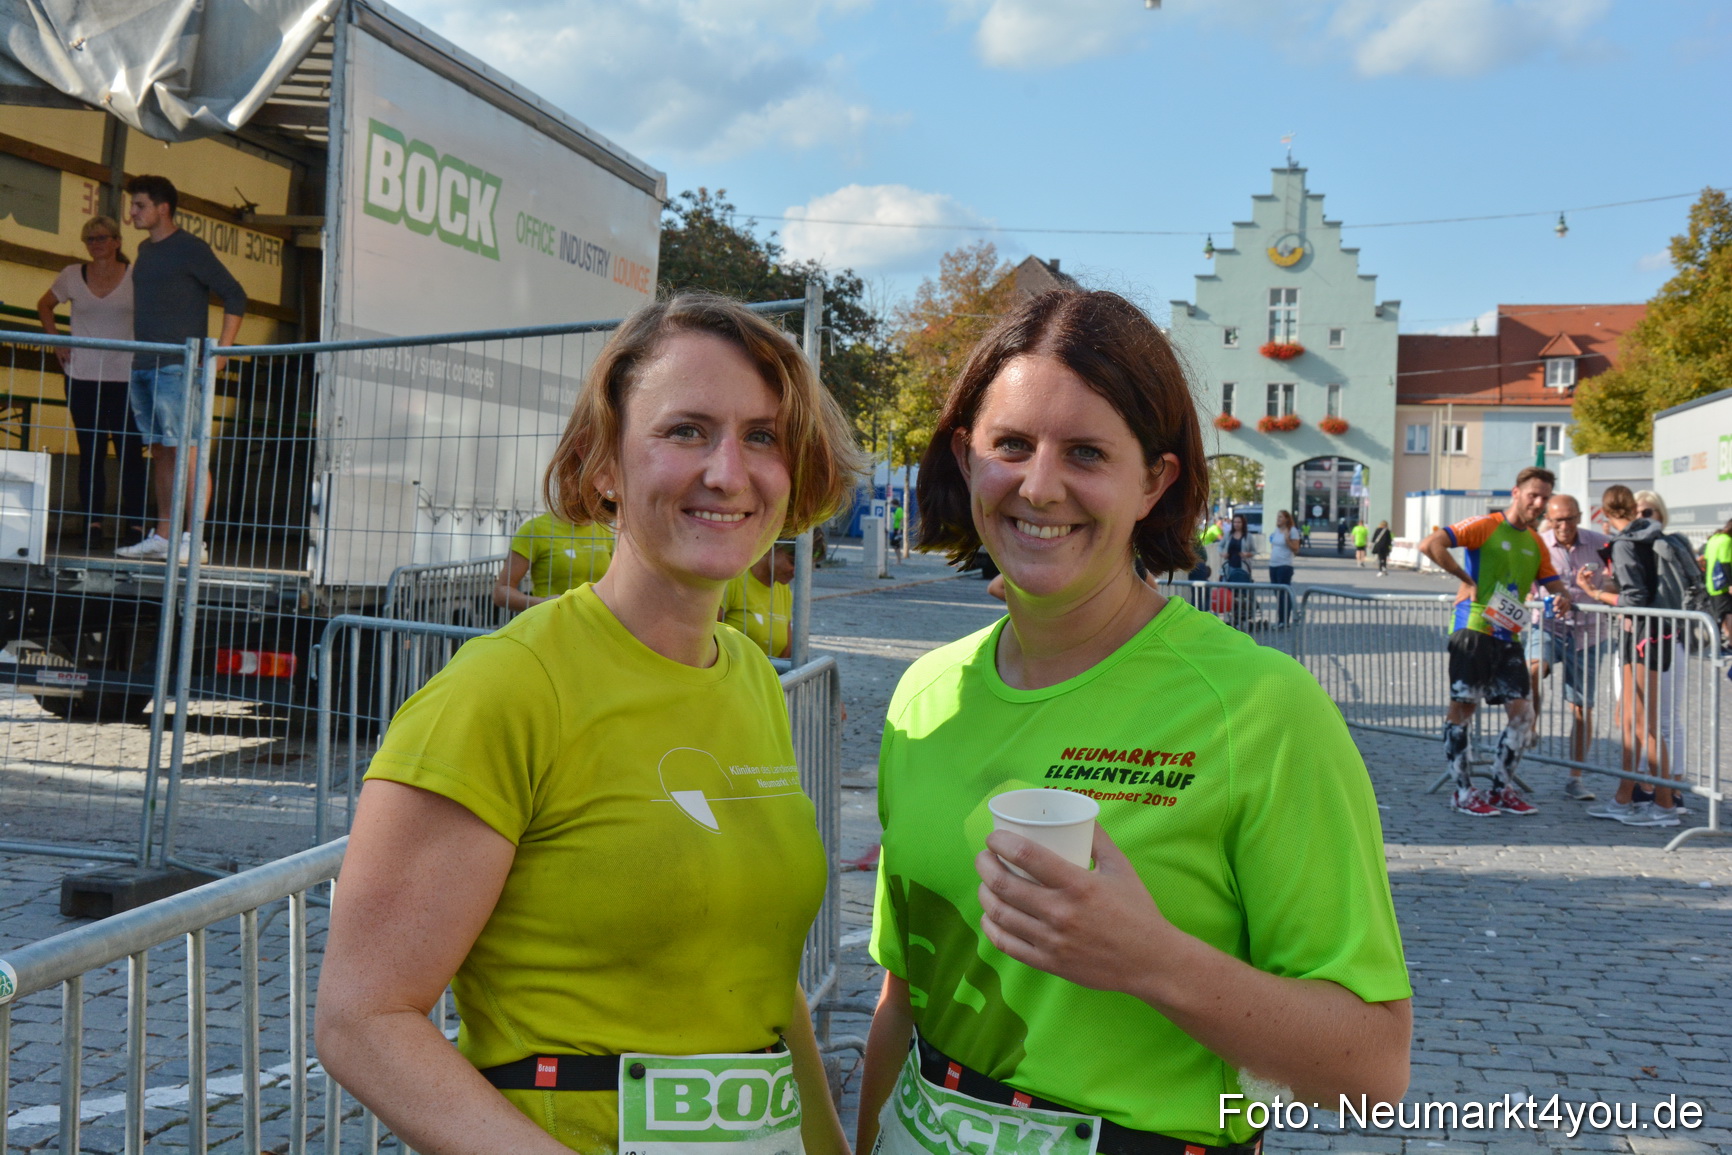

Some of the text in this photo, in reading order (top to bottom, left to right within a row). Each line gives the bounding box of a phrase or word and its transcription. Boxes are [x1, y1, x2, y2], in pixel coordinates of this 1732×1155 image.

[366, 130, 499, 252] BOCK
[516, 211, 652, 295] OFFICE INDUSTRY LOUNGE
[420, 356, 450, 380] smart
[452, 361, 495, 392] concepts
[1497, 598, 1524, 621] 530
[1060, 747, 1196, 767] NEUMARKTER
[728, 765, 760, 775] Kliniken
[1044, 765, 1195, 790] ELEMENTELAUF
[757, 779, 788, 788] Neumarkt
[1142, 793, 1178, 807] 2019
[537, 1063, 556, 1073] Braun
[650, 1070, 798, 1124] BOC
